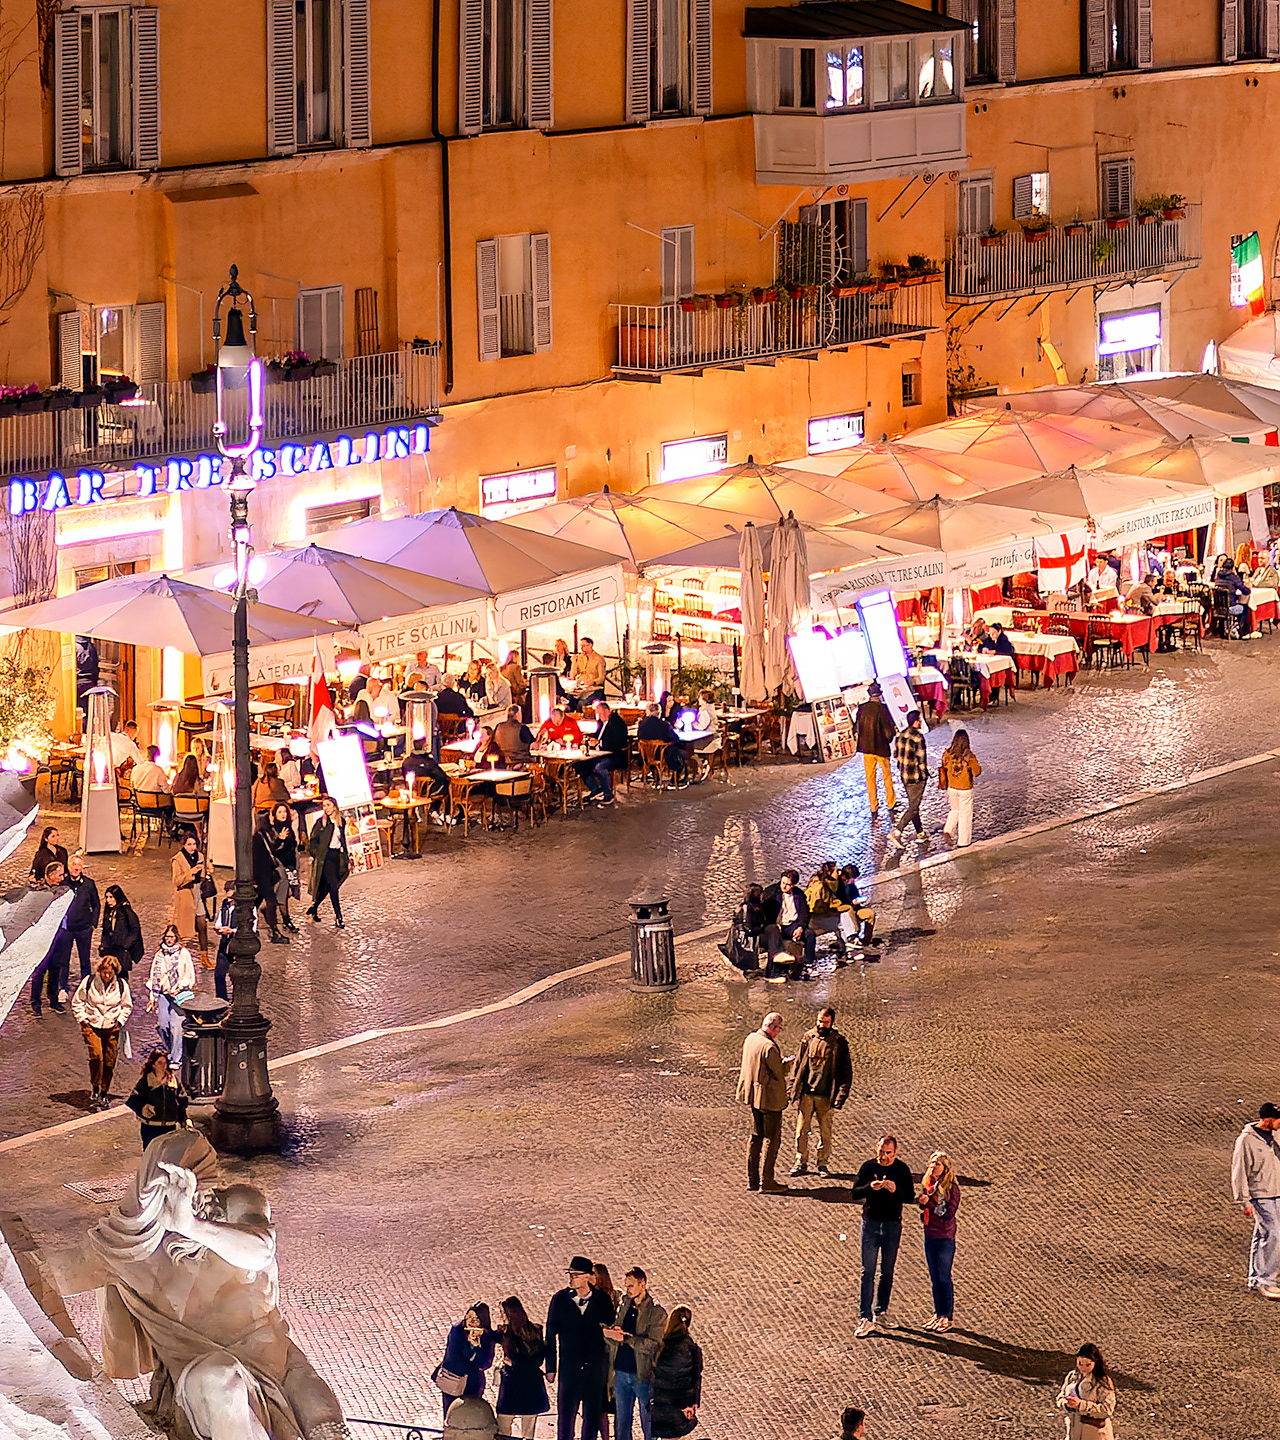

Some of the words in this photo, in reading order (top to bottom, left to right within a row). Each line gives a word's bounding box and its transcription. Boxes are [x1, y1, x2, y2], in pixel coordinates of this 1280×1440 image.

[9, 469, 105, 517] BAR
[134, 453, 224, 497] TRE
[250, 423, 431, 481] SCALINI
[1126, 511, 1170, 534] RISTORANTE
[1170, 508, 1185, 522] TRE
[1185, 501, 1212, 519] SCALINI
[897, 568, 913, 583] TRE
[913, 561, 945, 580] SCALINI
[519, 586, 601, 621] RISTORANTE
[376, 631, 406, 652] TRE
[410, 617, 469, 643] SCALINI
